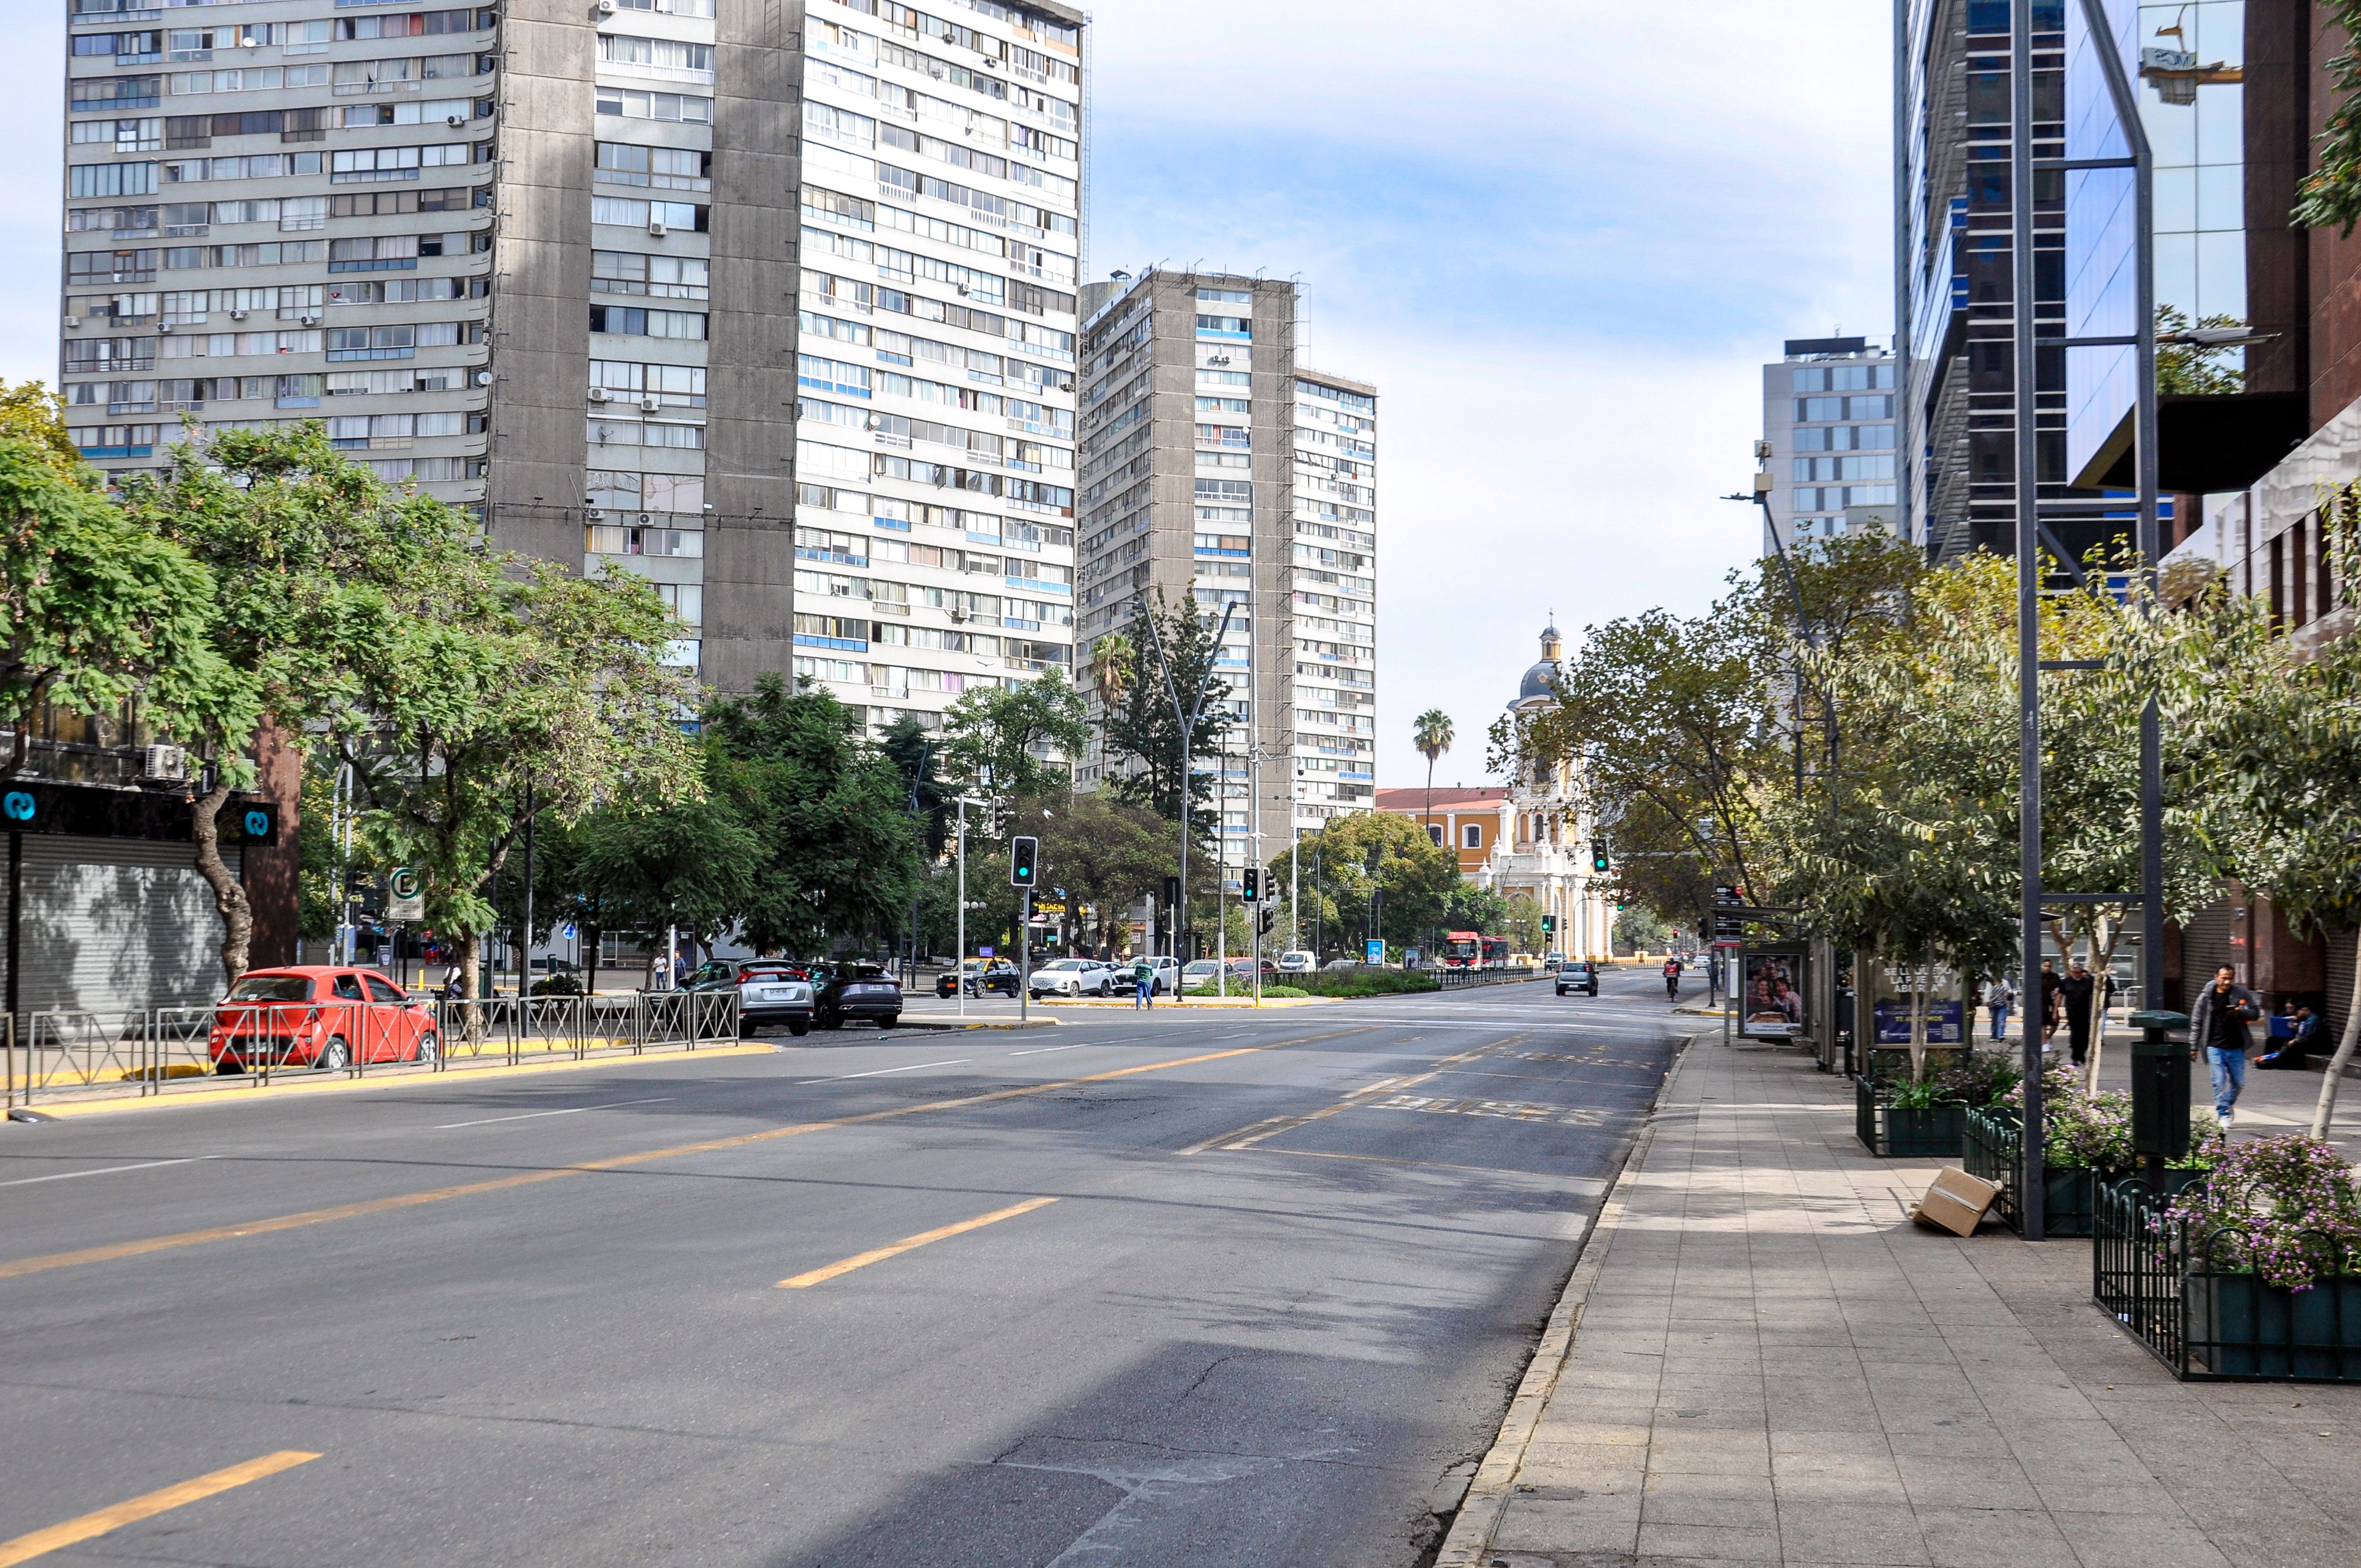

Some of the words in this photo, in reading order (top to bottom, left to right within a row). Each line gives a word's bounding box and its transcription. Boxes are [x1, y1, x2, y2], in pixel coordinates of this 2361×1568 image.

[400, 875, 412, 893] E
[1889, 976, 1904, 984] LA
[1367, 1095, 1614, 1126] BUSES
